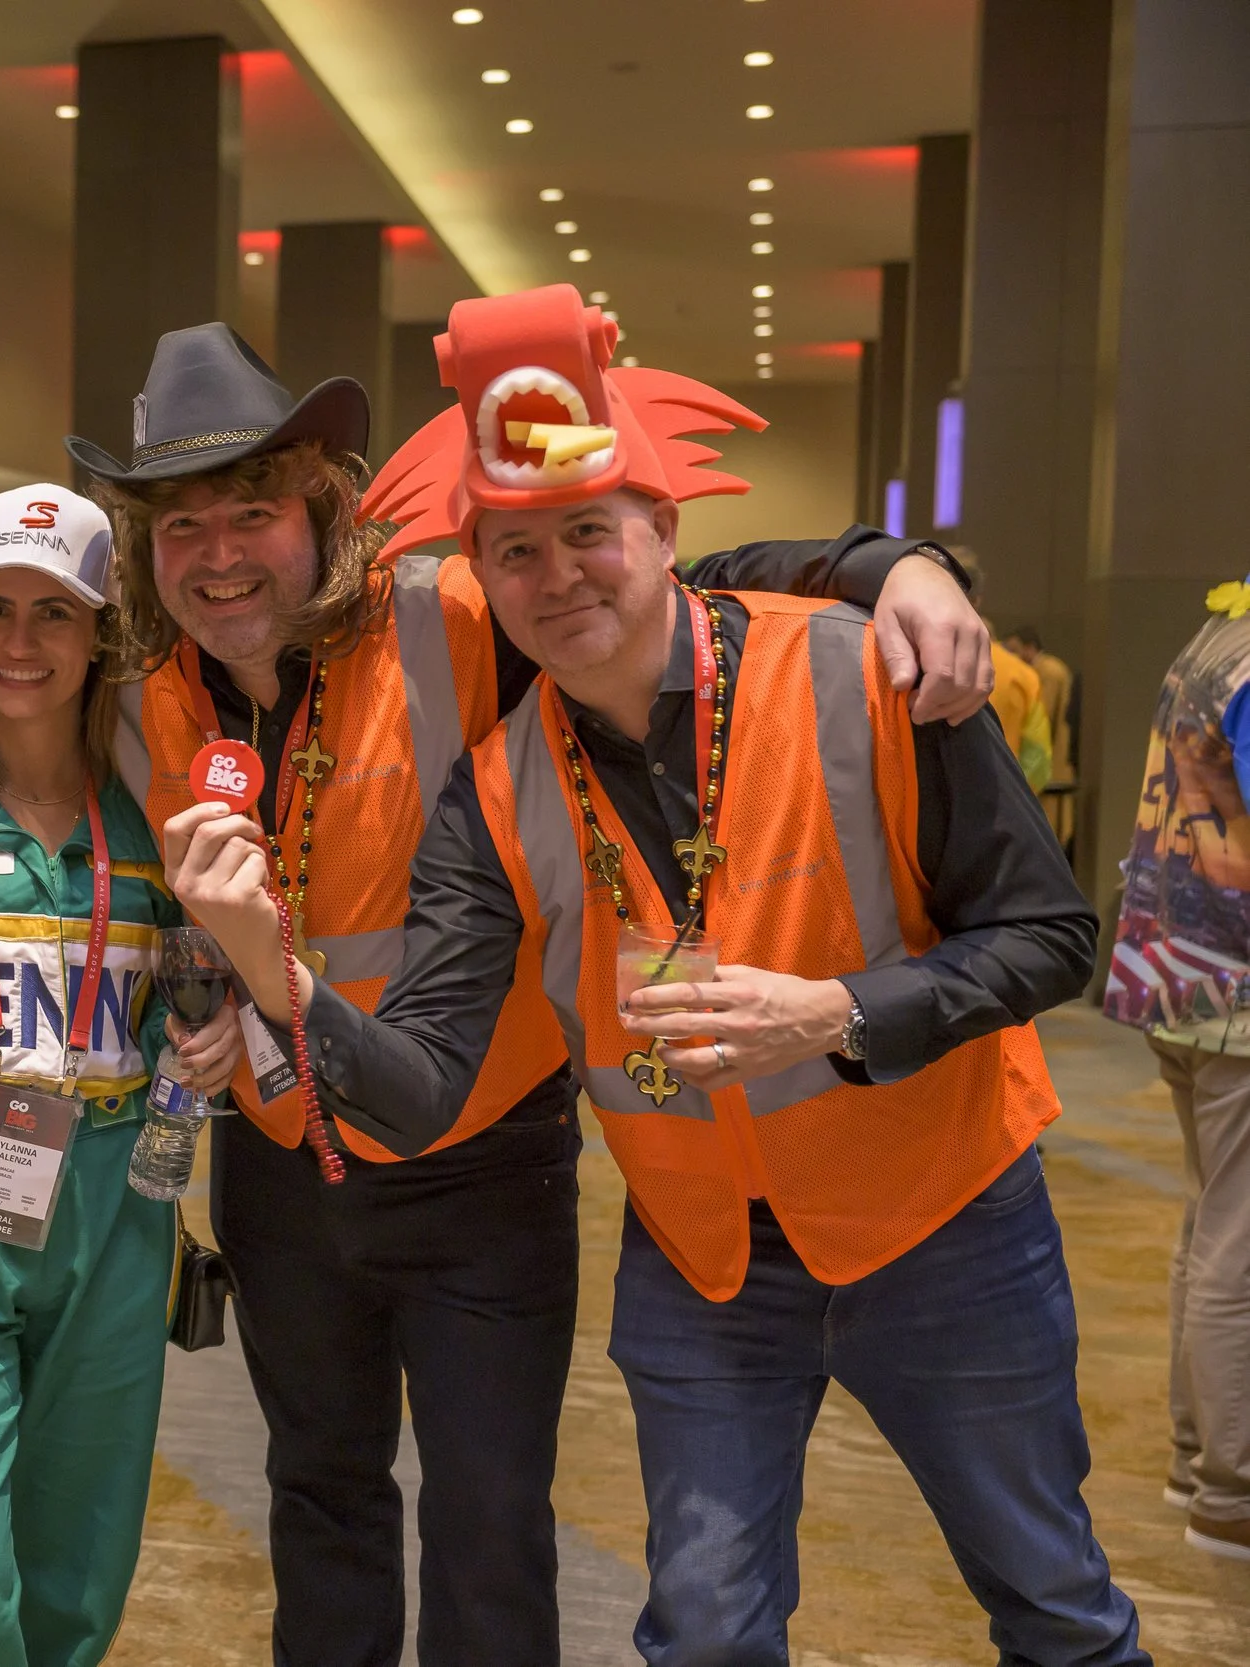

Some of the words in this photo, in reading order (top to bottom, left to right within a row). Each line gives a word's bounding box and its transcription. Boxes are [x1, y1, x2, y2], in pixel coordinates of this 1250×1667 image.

[695, 606, 710, 677] HALACADEMY
[211, 753, 236, 770] GO
[205, 765, 248, 792] BIG
[93, 880, 106, 948] HALACADEMY
[88, 953, 98, 980] 2025
[270, 1071, 283, 1085] FIRST
[9, 1099, 30, 1113] GO
[5, 1109, 38, 1131] BIG
